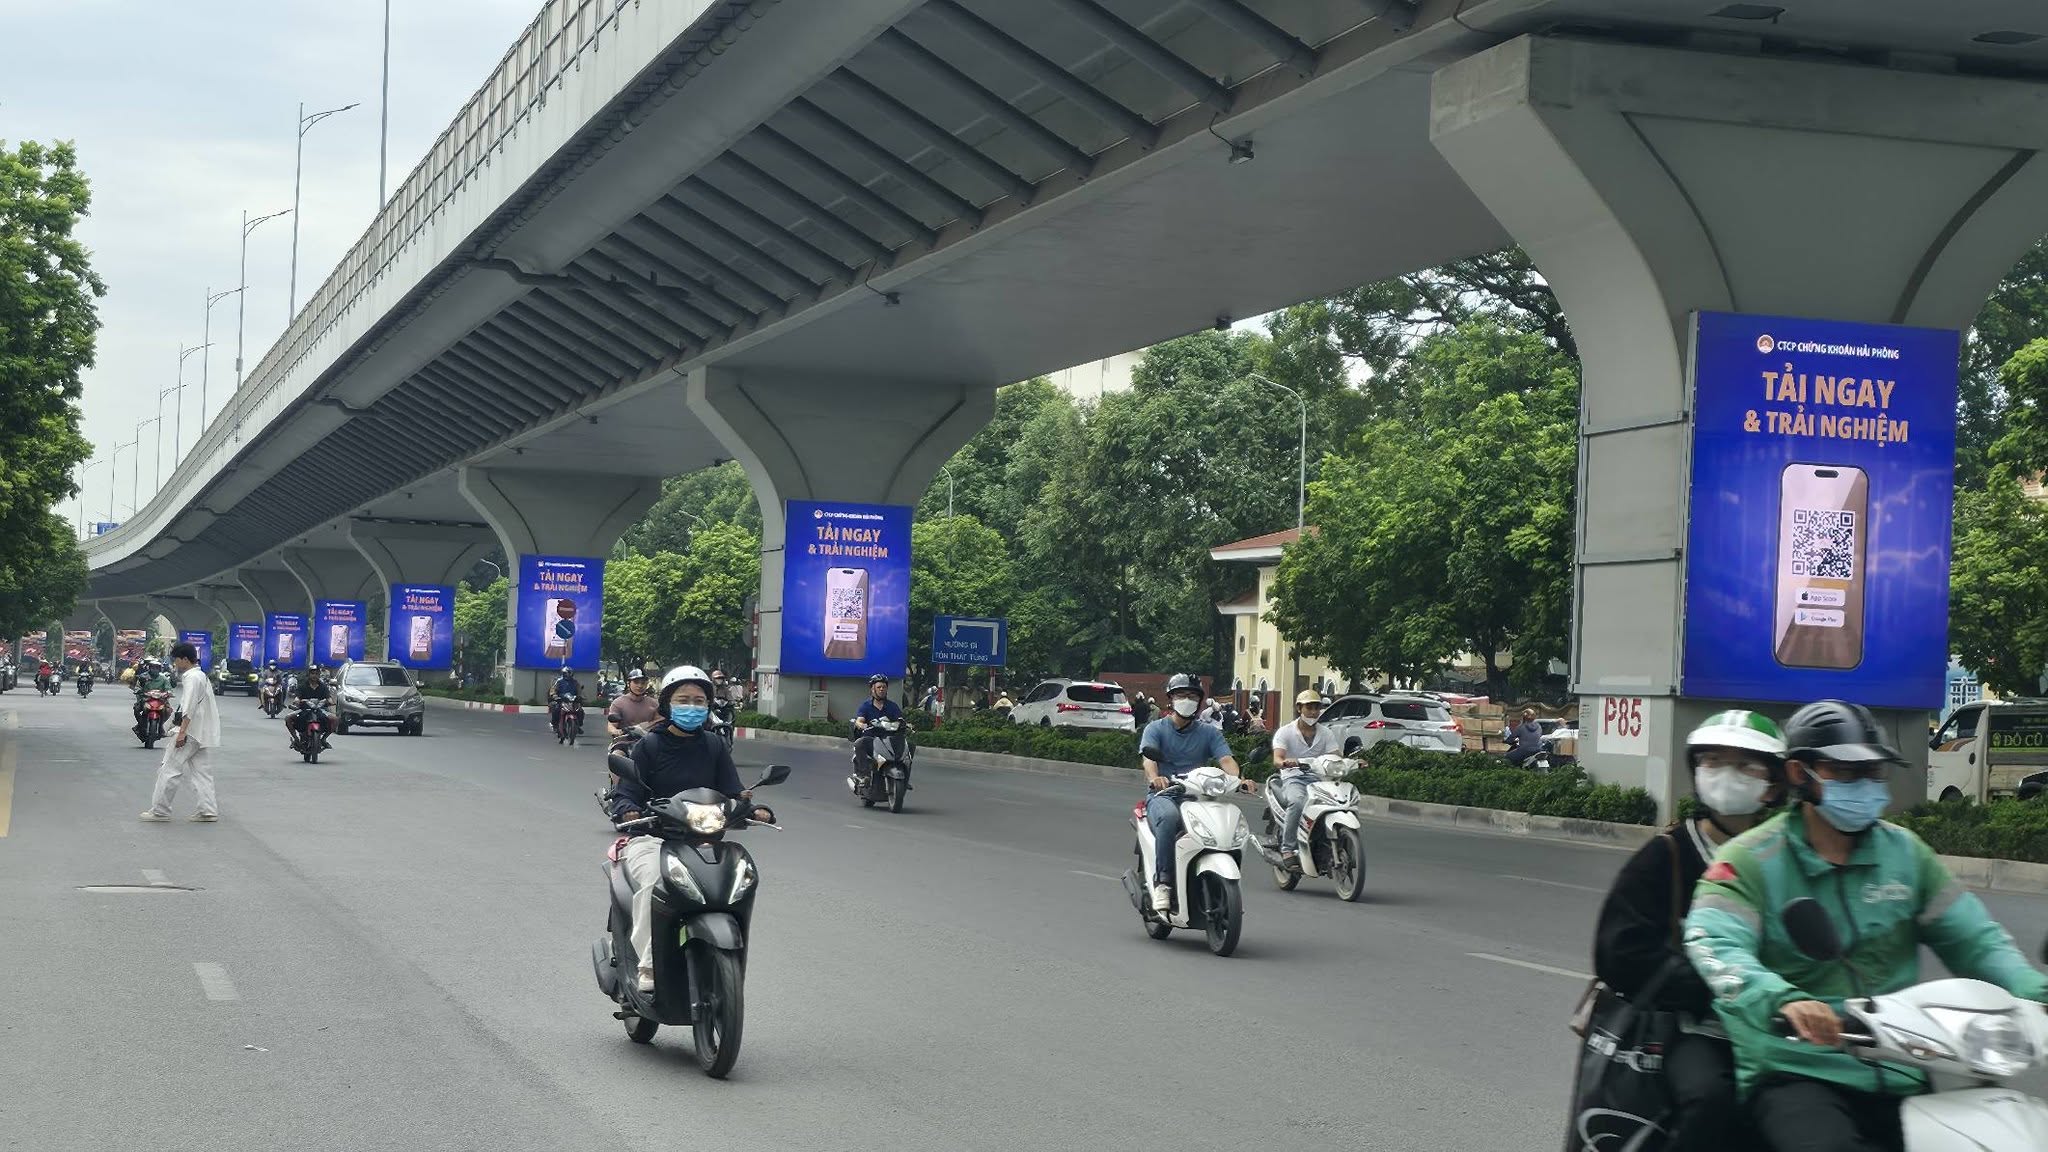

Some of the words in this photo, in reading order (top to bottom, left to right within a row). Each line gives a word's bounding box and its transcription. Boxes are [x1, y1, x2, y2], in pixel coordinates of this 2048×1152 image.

[1777, 341, 1796, 351] CTCP
[1797, 341, 1827, 354] CHỨNG
[1828, 343, 1856, 356] KHOÁN
[1856, 344, 1871, 357] HẢI
[1872, 347, 1900, 359] PHÒNG
[1762, 362, 1807, 403] TẢI
[1815, 375, 1895, 409] NGAY
[1744, 409, 1761, 433] &
[1766, 405, 1814, 436] TRẢI
[1820, 413, 1909, 448] NGHIỆM
[816, 522, 839, 541] TẢI
[842, 527, 881, 543] NGAY
[808, 544, 817, 555] &
[819, 541, 843, 556] TRẢI
[845, 544, 888, 560] NGHIỆM
[540, 569, 555, 581] TẢI
[557, 573, 584, 583] NGAY
[1604, 697, 1642, 737] P85
